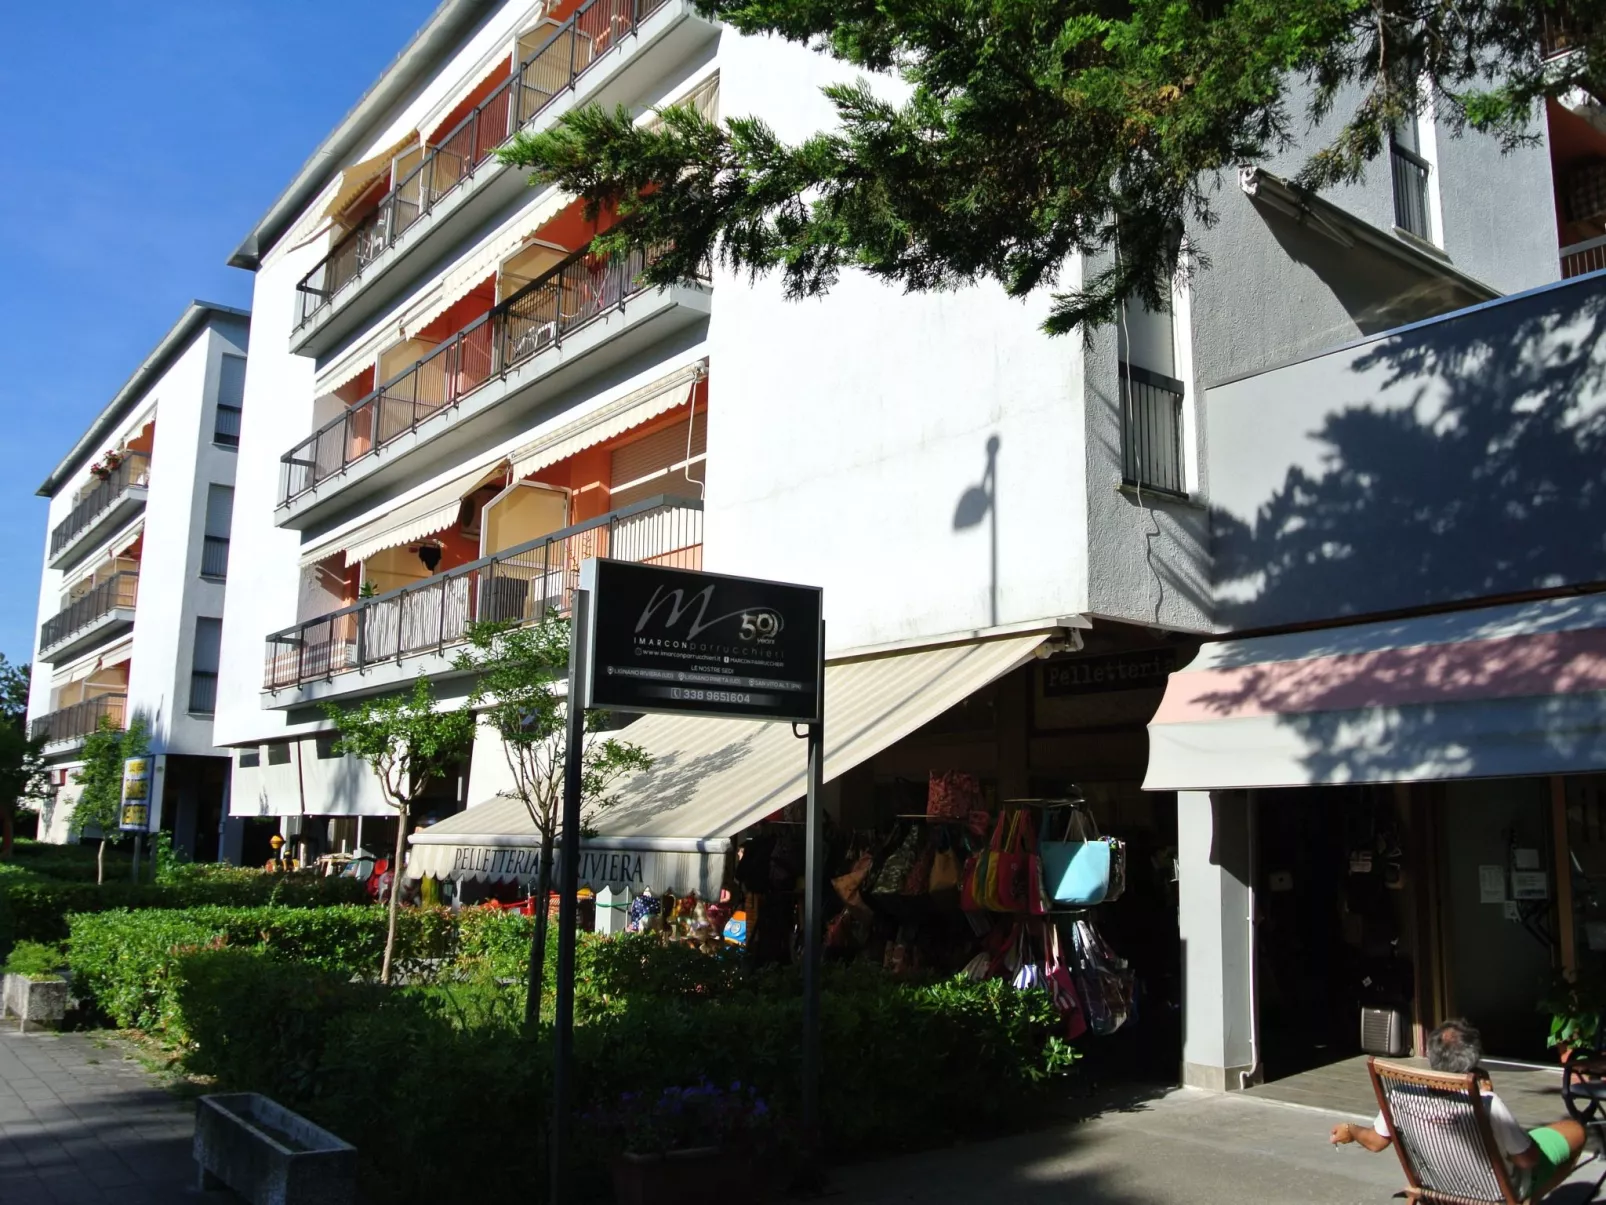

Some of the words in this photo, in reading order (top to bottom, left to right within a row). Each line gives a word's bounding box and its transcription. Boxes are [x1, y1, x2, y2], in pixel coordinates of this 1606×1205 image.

[614, 668, 639, 676] LIGNANO
[697, 665, 721, 673] NOSTRE
[721, 667, 735, 675] SEDI
[1048, 655, 1176, 687] Pelletteria
[683, 689, 704, 700] 338
[706, 691, 751, 704] 9651604
[453, 847, 539, 875] PELLETTERIA
[577, 852, 644, 883] IVIERA
